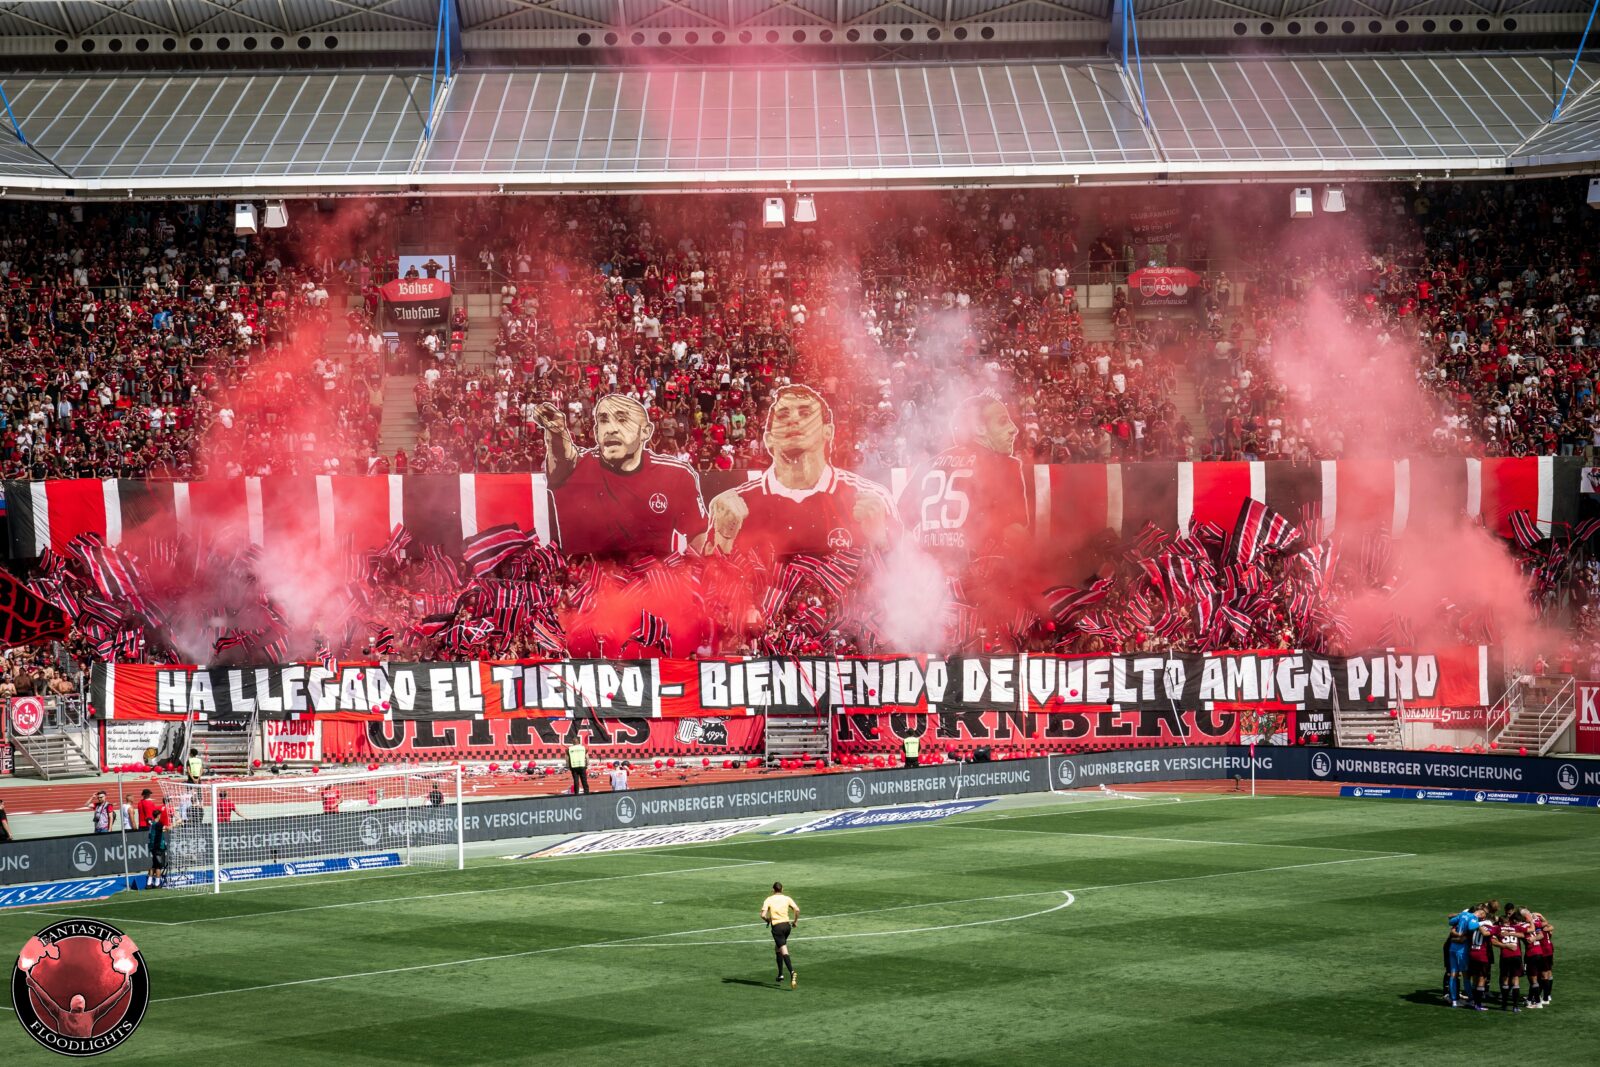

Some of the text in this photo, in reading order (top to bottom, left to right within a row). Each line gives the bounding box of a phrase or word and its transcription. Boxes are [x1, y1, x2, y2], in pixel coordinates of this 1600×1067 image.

[398, 282, 434, 296] Böhse
[921, 469, 974, 532] 25
[156, 670, 217, 712] HA
[228, 664, 417, 713] LLEGADO
[429, 666, 483, 712] EL
[492, 663, 645, 710] TIEMPO
[700, 659, 948, 708] BIENVENIDO
[962, 658, 1014, 703] DE
[1029, 656, 1187, 705] VUELTO
[1199, 655, 1332, 702] AMIGO
[267, 719, 315, 736] STADION
[1299, 722, 1317, 731] WILL
[1308, 713, 1324, 722] YOU
[705, 730, 726, 741] 1994
[267, 741, 315, 760] VERBOT
[1079, 755, 1273, 778] NÜRNBERGER VERSICHERUNG
[1336, 757, 1523, 782] NÜRNBERGER VERSICHERUNG
[870, 769, 1030, 795] NÜRNBERGER VERSICHERUNG
[641, 787, 817, 815] NÜRNBERGER VERSICHERUNG
[483, 806, 583, 829] VERSICHERUNG
